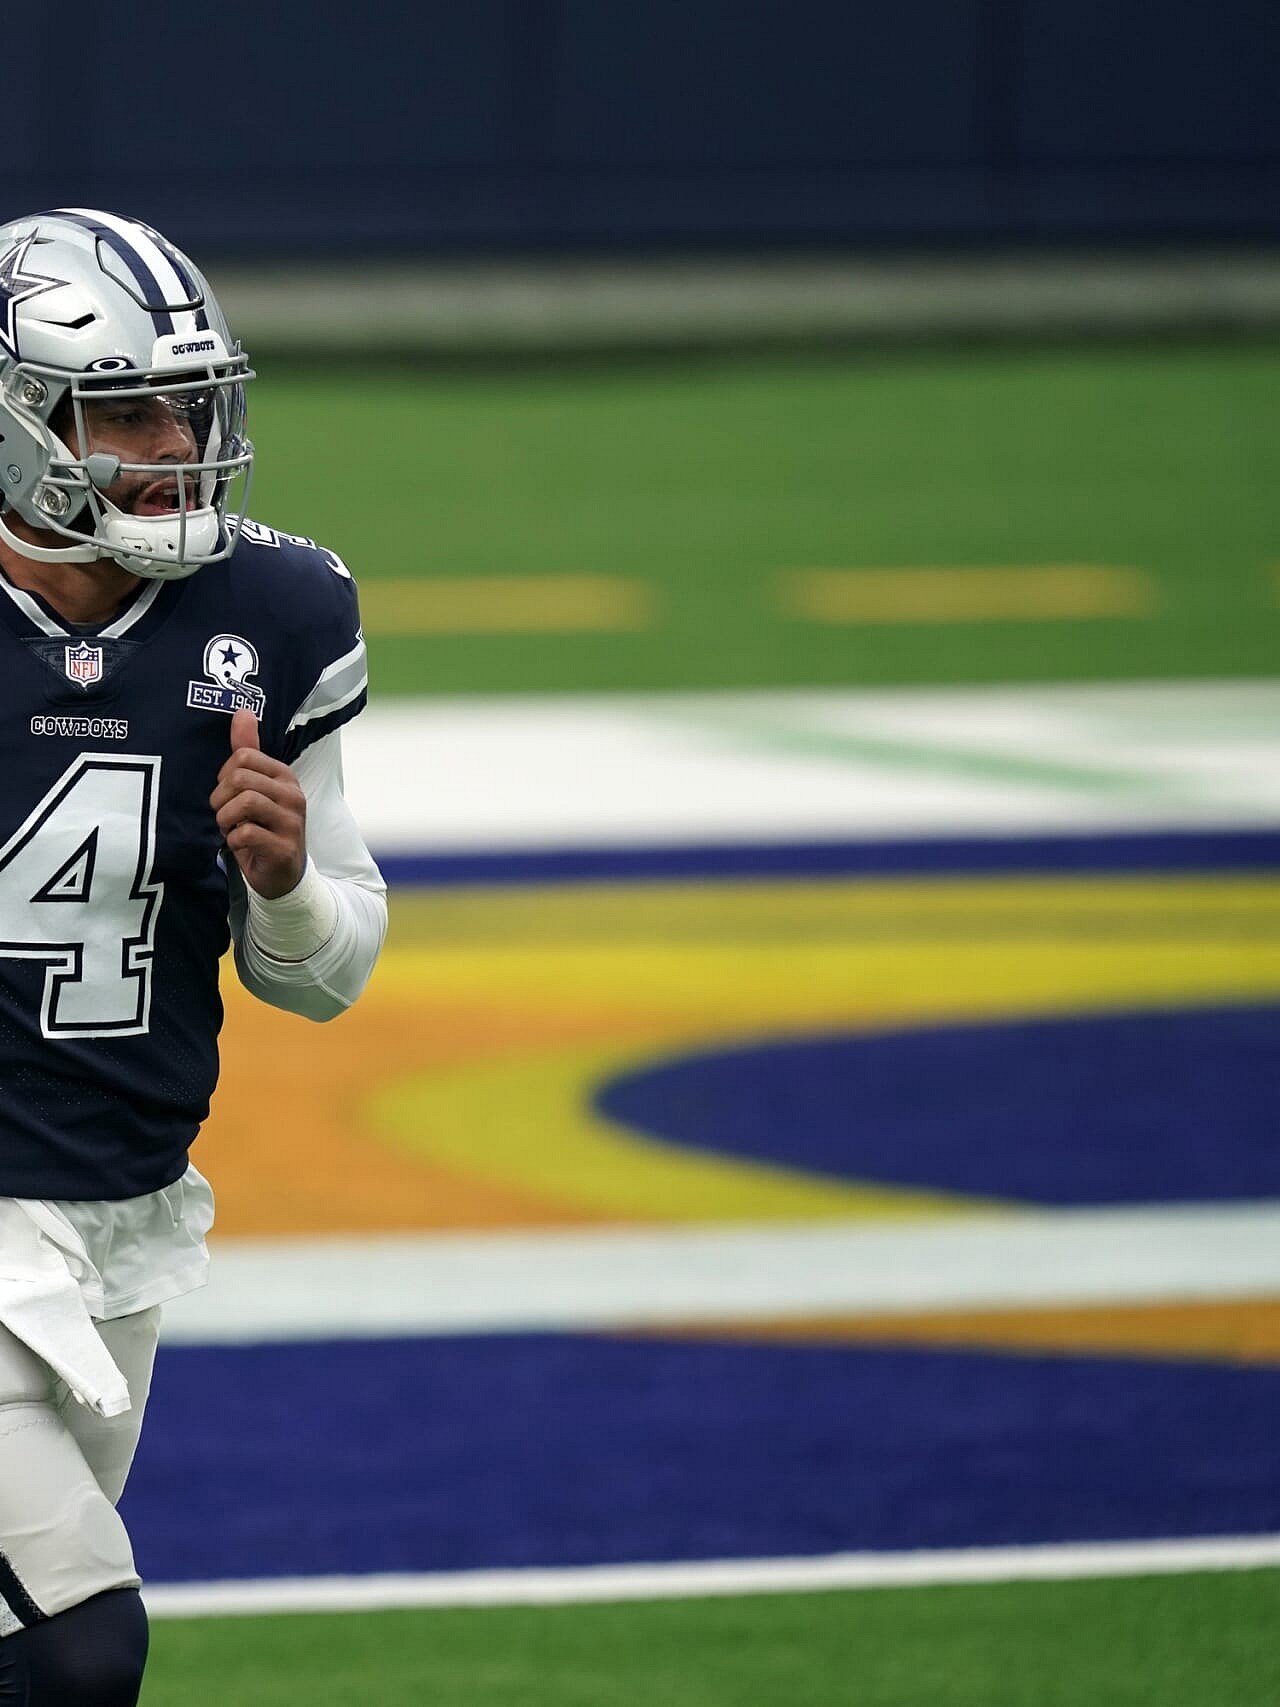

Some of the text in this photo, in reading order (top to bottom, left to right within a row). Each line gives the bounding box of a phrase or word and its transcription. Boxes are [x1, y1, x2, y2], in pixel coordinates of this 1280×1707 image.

[72, 661, 97, 678] NFL
[192, 687, 224, 706] EST.
[31, 716, 129, 739] COWBOYS
